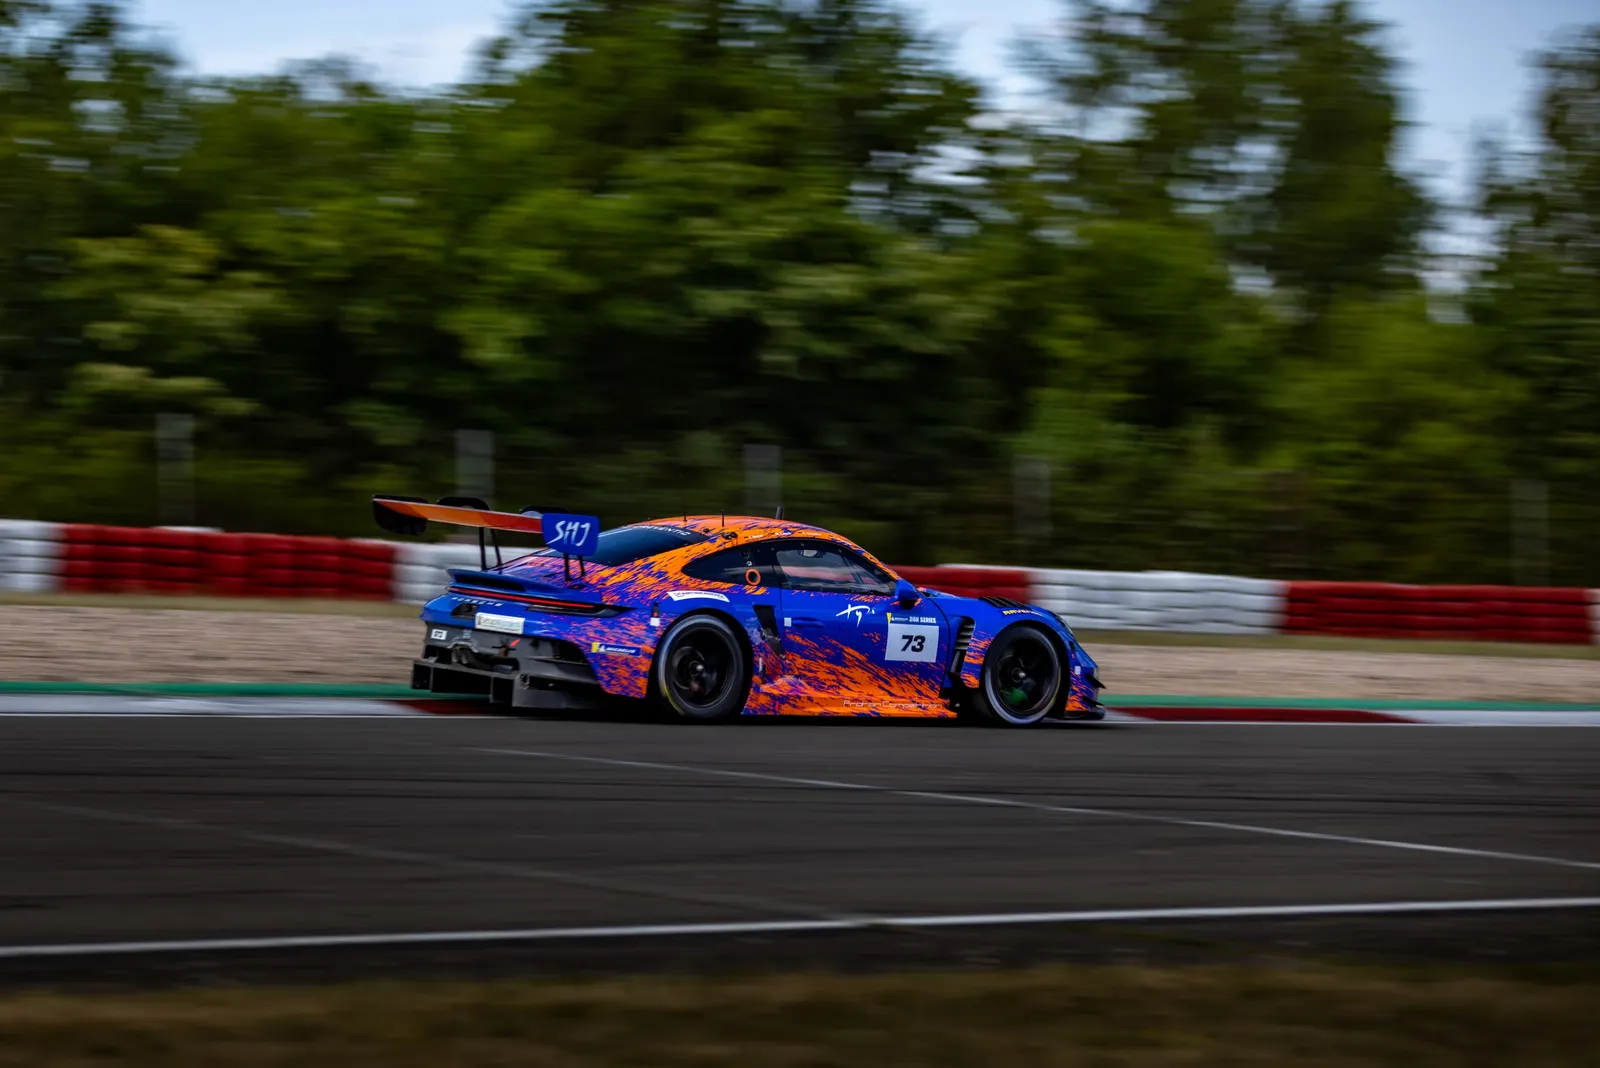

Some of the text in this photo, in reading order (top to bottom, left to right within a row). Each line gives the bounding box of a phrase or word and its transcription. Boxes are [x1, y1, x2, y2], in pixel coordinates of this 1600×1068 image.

[920, 616, 937, 624] SERIES
[901, 634, 926, 652] 73
[843, 700, 942, 709] Proton Competition
